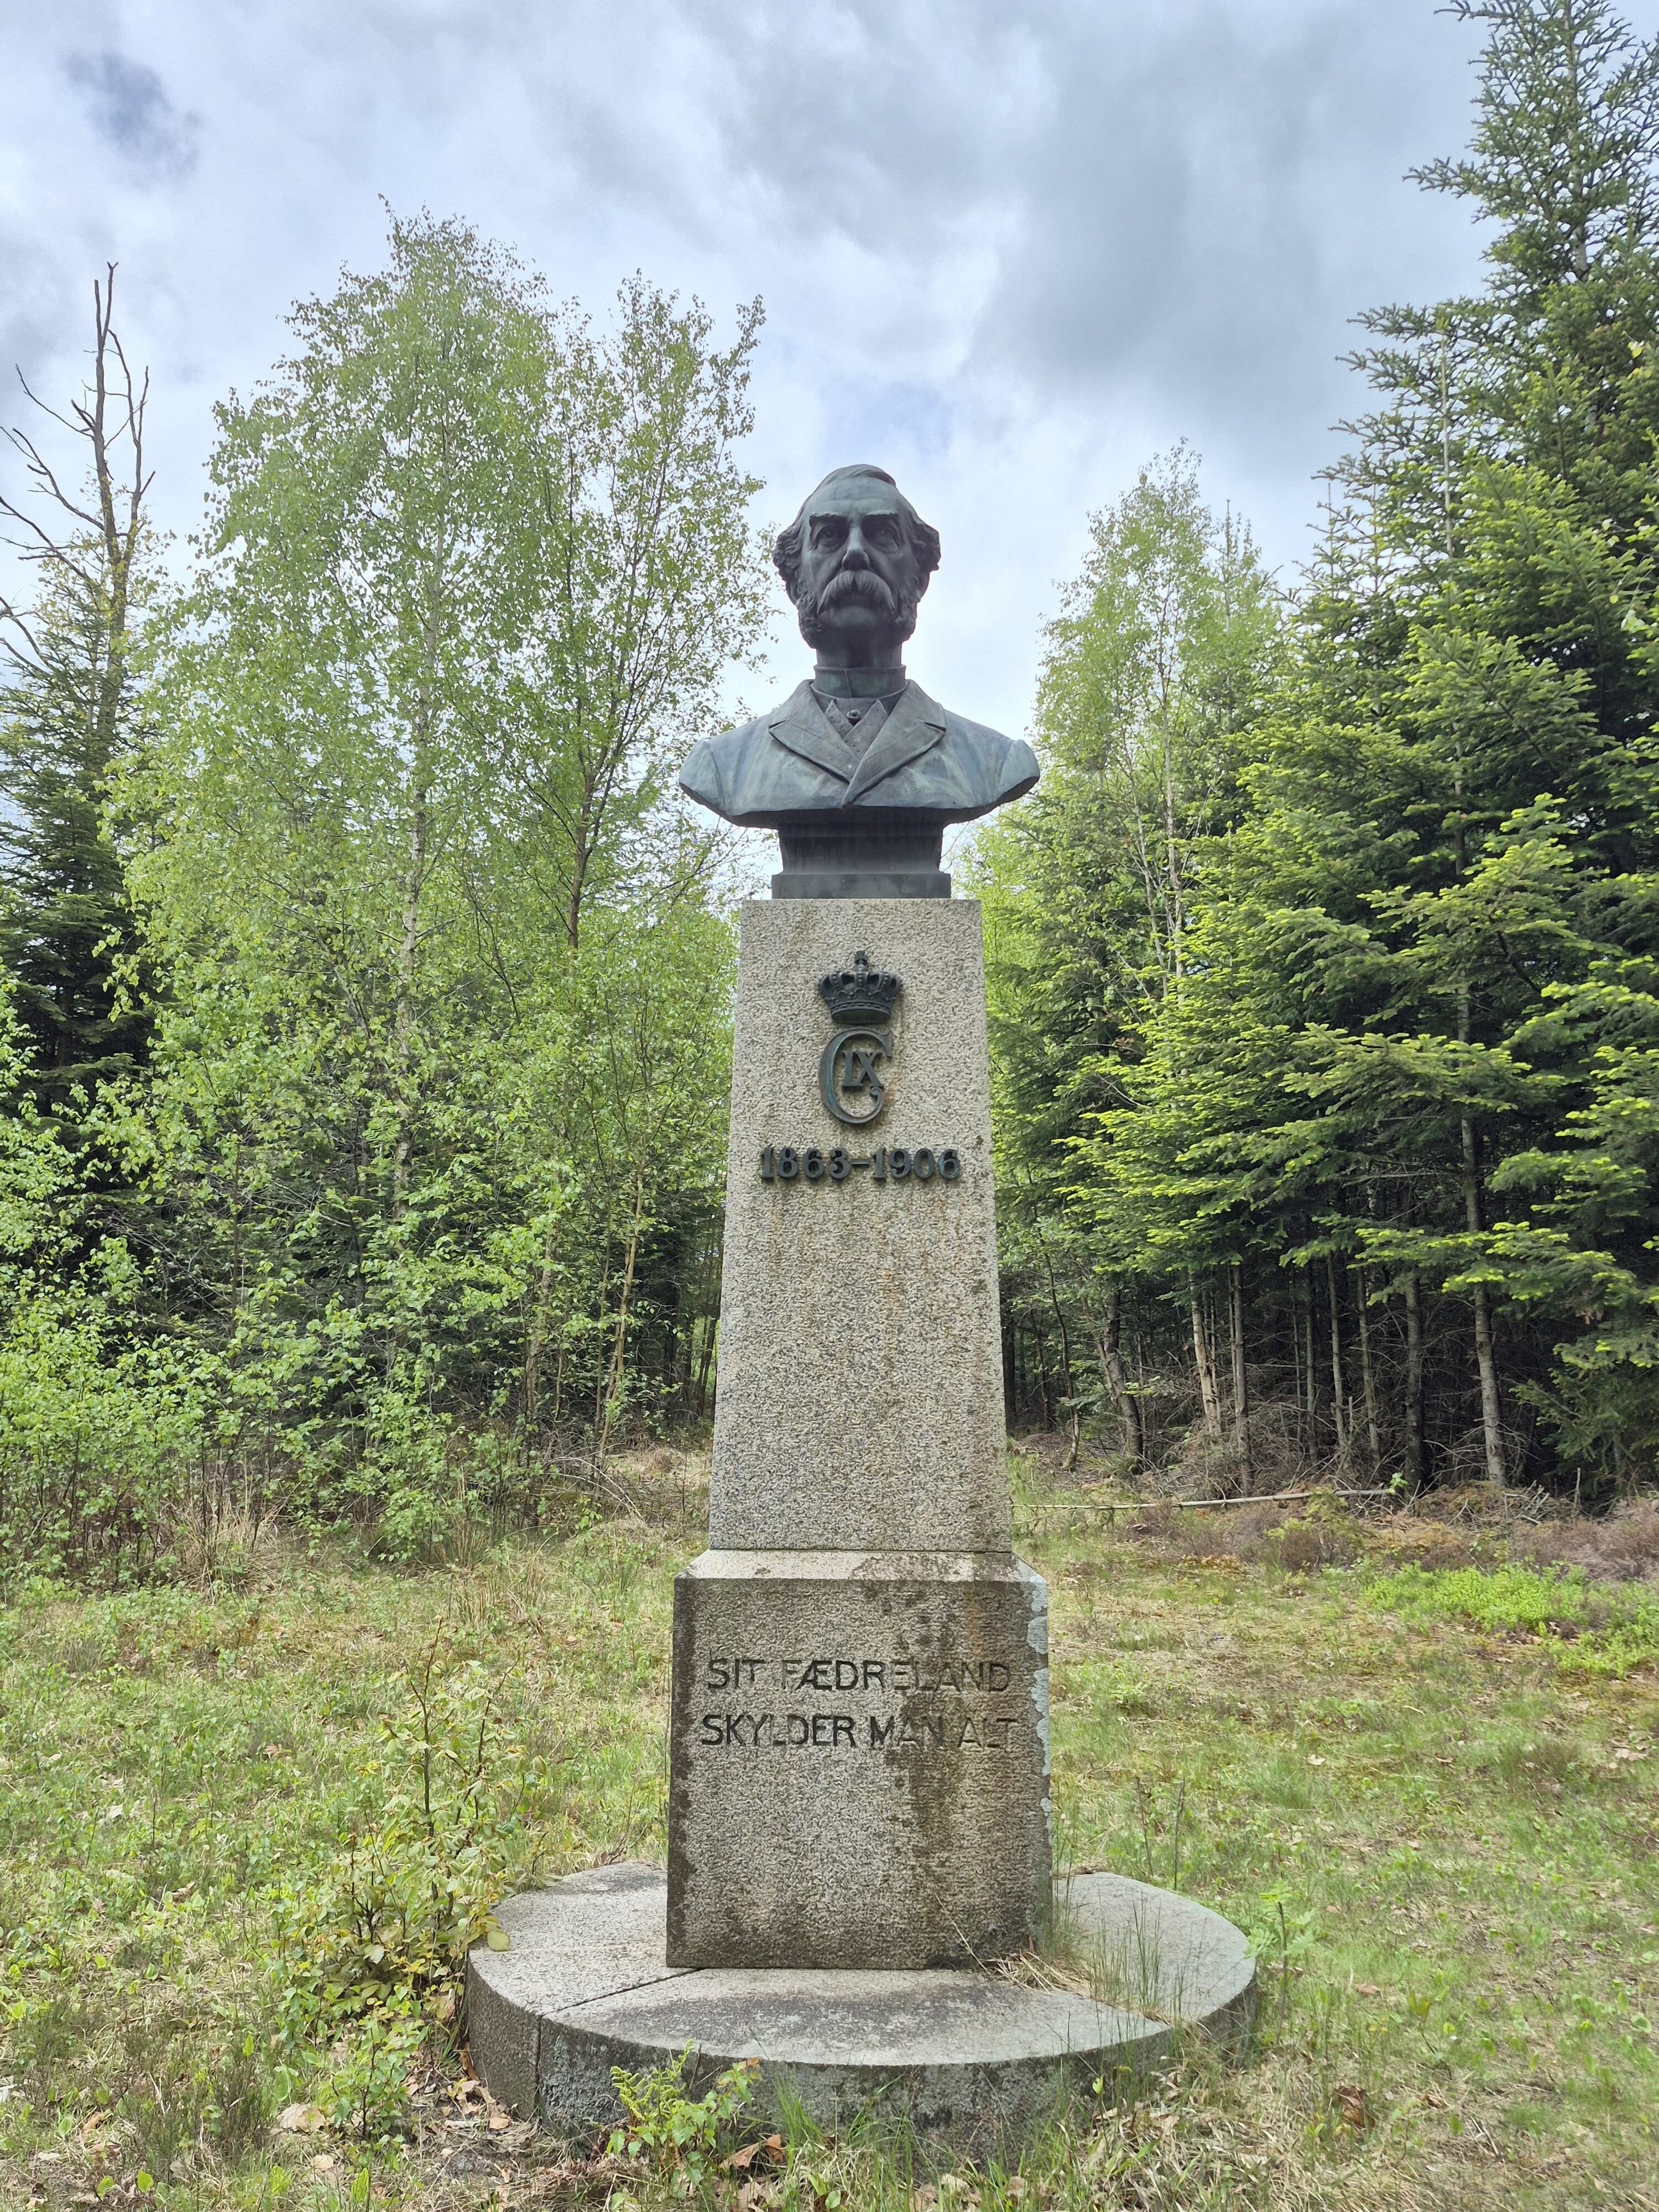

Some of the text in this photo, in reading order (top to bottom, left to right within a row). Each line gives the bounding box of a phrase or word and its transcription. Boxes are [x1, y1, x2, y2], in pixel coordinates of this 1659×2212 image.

[761, 1146, 960, 1180] 1863-1906
[708, 1659, 1011, 1692] SIT FÆDRELAND
[702, 1714, 1018, 1750] SKYLDER MAN ALT
